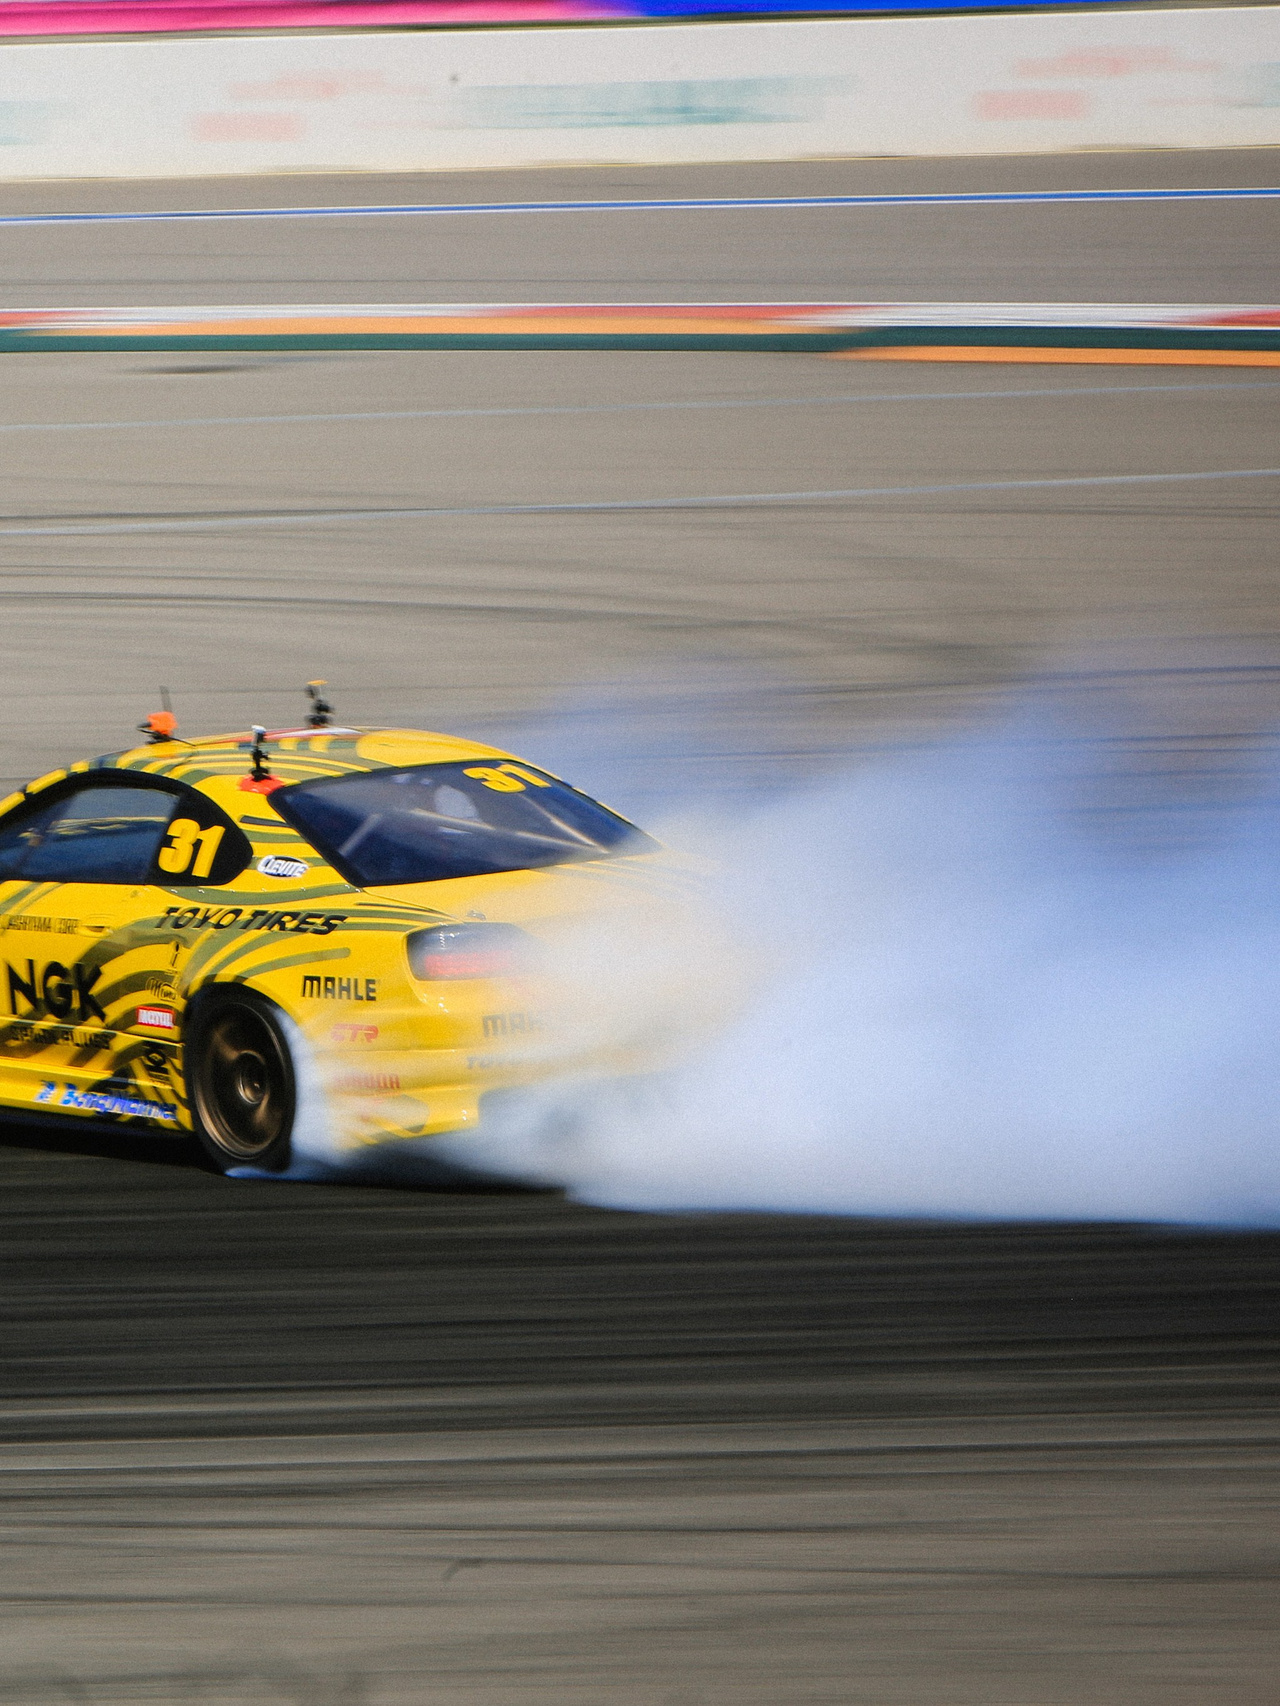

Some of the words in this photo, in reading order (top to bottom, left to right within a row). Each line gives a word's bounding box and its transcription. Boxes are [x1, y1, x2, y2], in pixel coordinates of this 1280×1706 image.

[462, 763, 551, 793] 31
[158, 818, 226, 878] 31
[258, 855, 309, 878] CLEVITE
[155, 906, 244, 930] TOYO
[239, 909, 349, 935] TIRES
[5, 958, 107, 1023] NGK
[302, 975, 377, 1001] MAHLE
